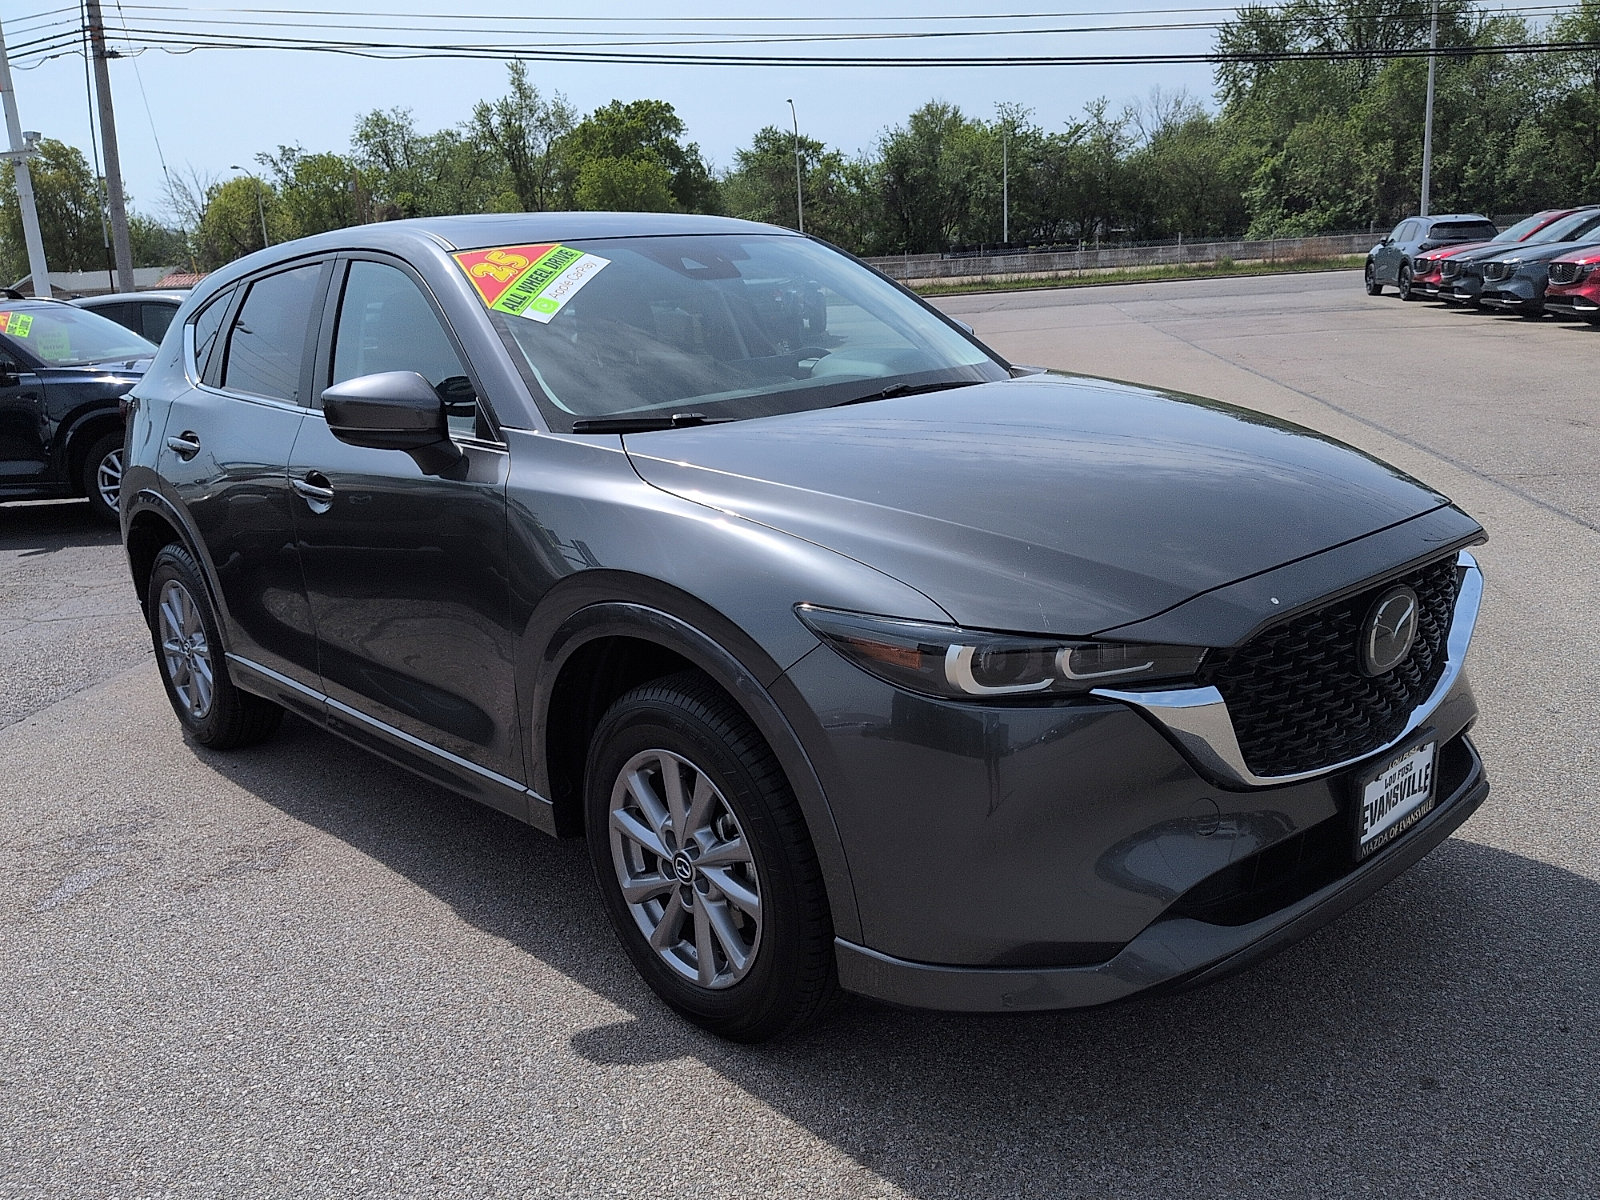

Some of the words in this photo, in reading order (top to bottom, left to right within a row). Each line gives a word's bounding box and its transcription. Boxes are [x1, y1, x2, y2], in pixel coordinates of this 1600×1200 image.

[471, 250, 530, 282] 25
[502, 293, 528, 311] ALL
[516, 267, 553, 295] WHEEL
[546, 249, 577, 271] DRIVE
[549, 279, 574, 299] Apple
[567, 261, 597, 281] CarPlay
[1362, 762, 1431, 837] EVANSVILLE
[1384, 772, 1397, 789] LOU
[1362, 832, 1389, 857] MAZDA
[1389, 824, 1399, 839] OF
[1399, 799, 1433, 832] EVANSVILLE
